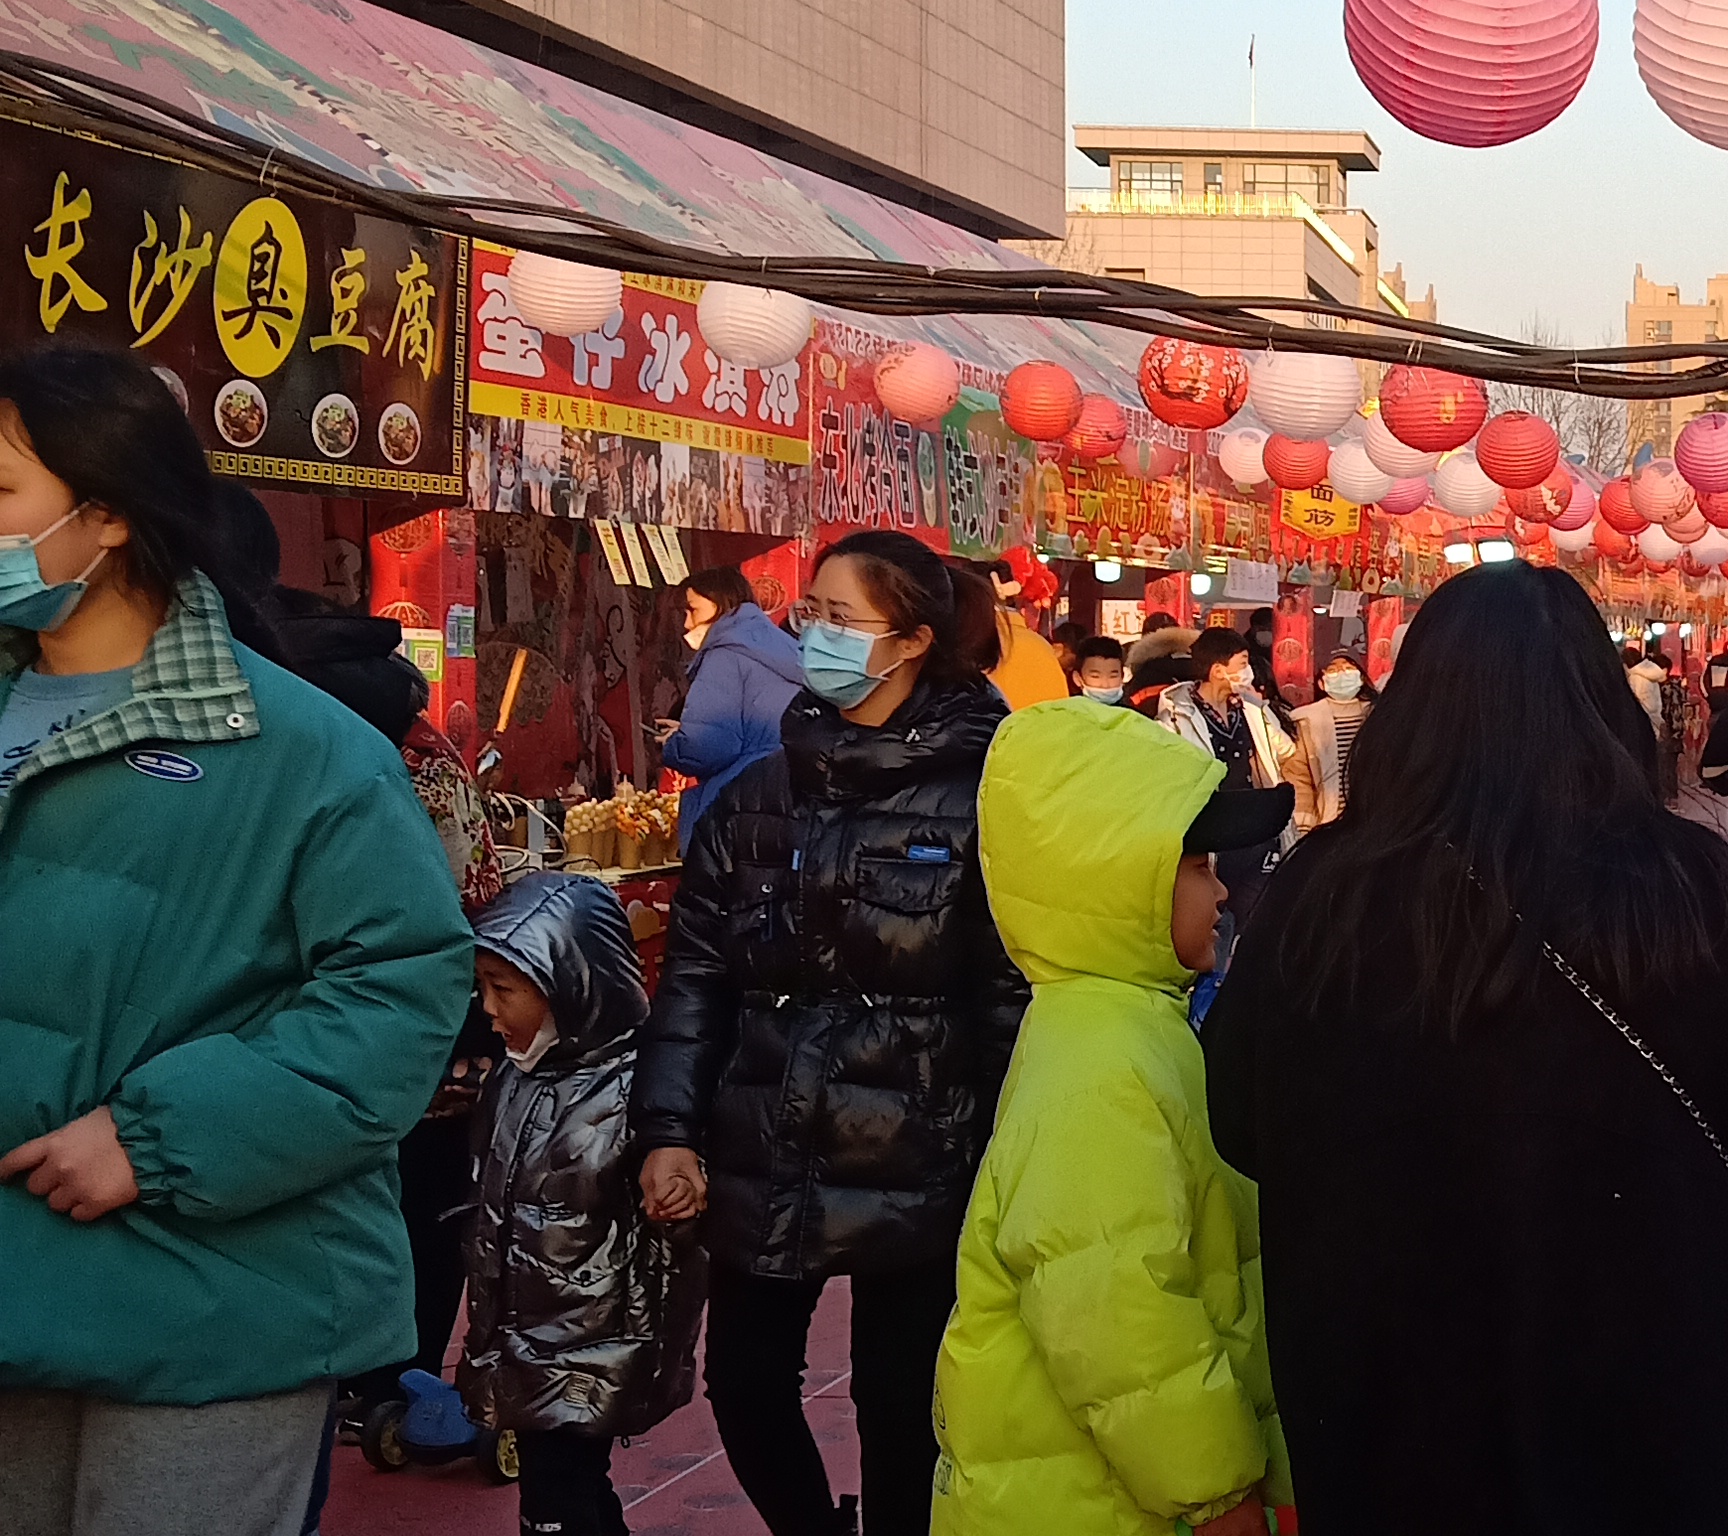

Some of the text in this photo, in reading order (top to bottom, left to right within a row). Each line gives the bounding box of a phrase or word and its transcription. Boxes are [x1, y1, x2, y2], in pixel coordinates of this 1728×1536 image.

[24, 170, 437, 382] 长沙臭豆腐
[818, 395, 917, 530] 东北烤冷面
[1066, 465, 1171, 536] 玉米淀粉肠
